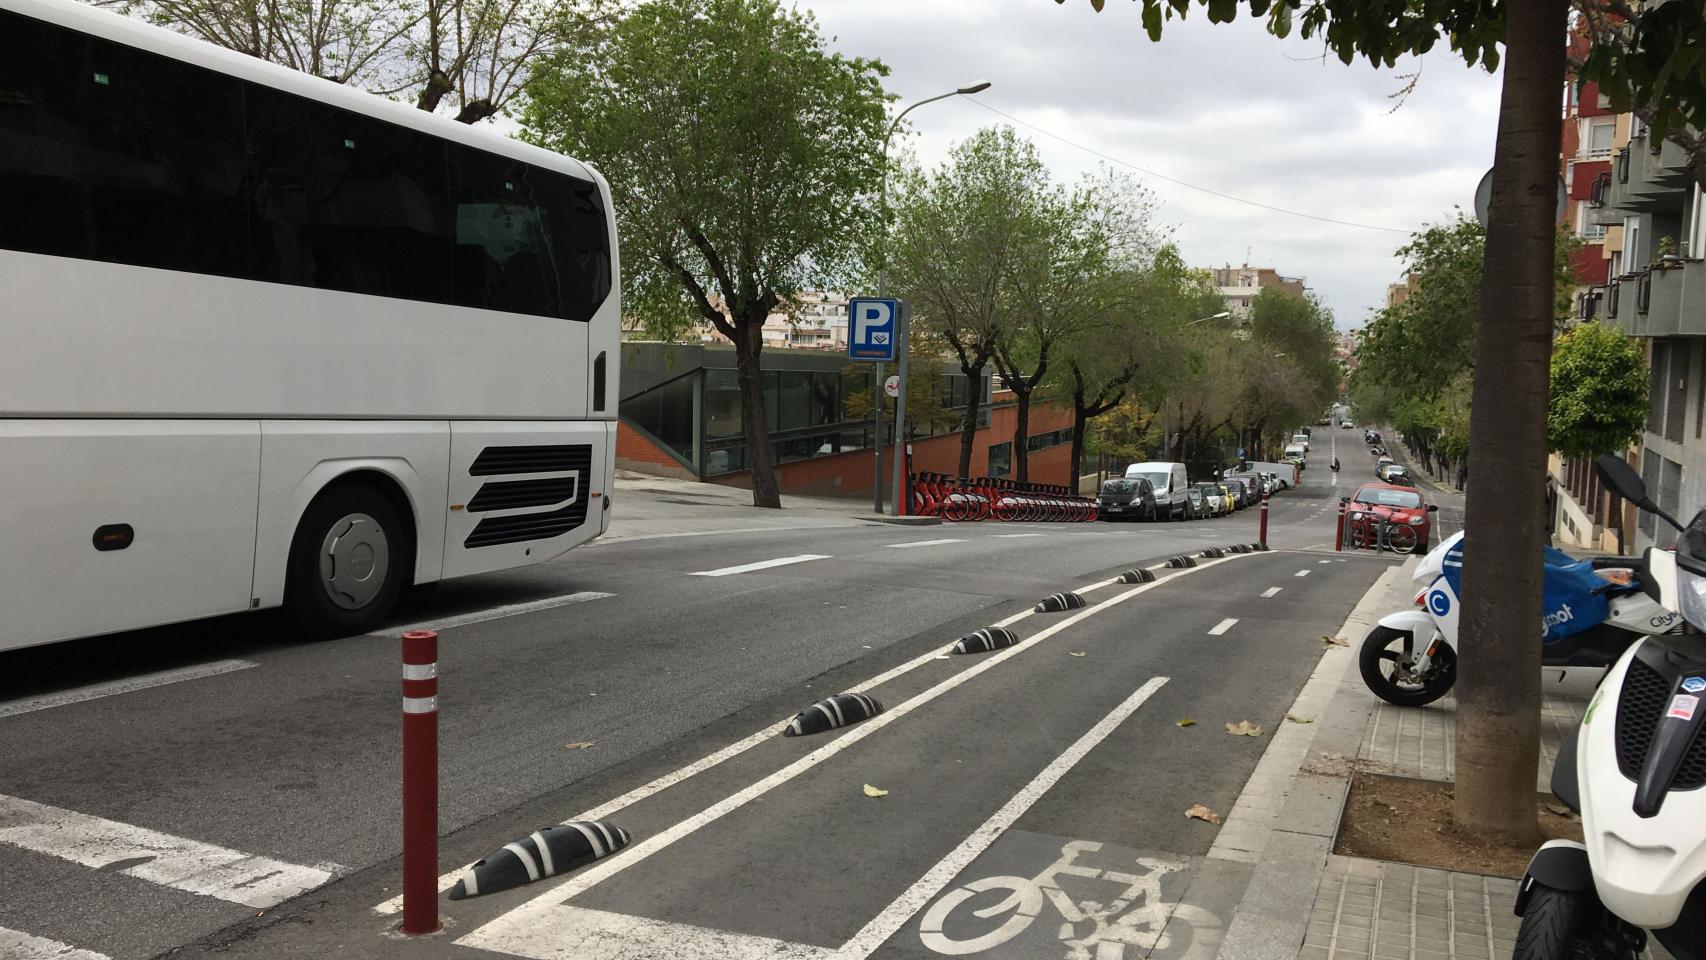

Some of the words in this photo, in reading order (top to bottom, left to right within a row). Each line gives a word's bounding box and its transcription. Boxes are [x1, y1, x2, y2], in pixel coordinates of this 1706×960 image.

[855, 302, 891, 344] P
[1432, 594, 1444, 612] C
[1650, 611, 1680, 628] Citys
